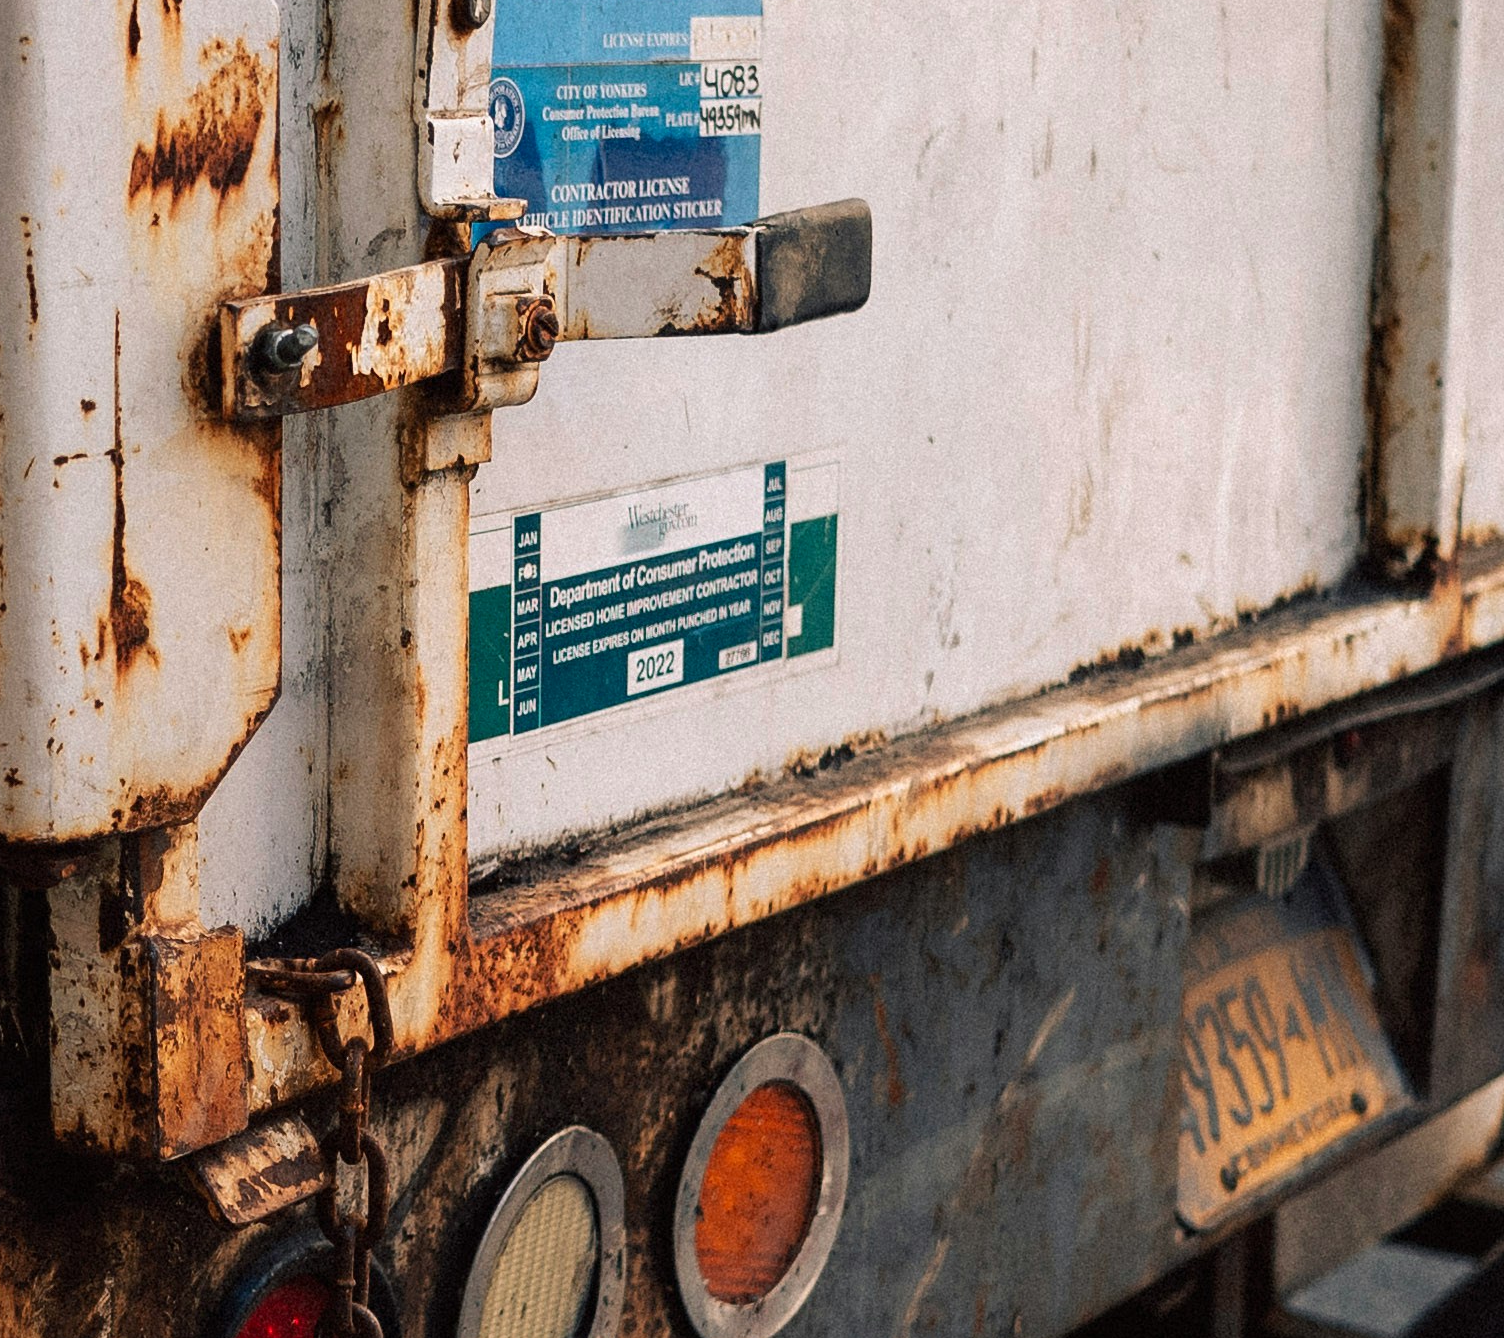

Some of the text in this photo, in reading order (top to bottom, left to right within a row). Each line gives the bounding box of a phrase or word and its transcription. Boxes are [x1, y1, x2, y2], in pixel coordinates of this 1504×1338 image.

[603, 32, 645, 48] LICENSE
[556, 83, 648, 100] CITY OF YONKERS
[705, 65, 759, 99] 4083
[542, 103, 660, 121] Consumer Protection Bureau
[561, 123, 641, 141] Office of Licensing
[551, 176, 690, 203] CONTRACTOR LICENSE
[572, 203, 673, 226] IDENTIFICATION
[673, 198, 722, 220] STICKER
[767, 476, 783, 493] JUL
[628, 502, 689, 529] Westchester
[765, 507, 783, 524] AUG
[518, 531, 537, 548] JAN
[765, 537, 782, 555] SEP
[518, 565, 537, 583] FB
[550, 541, 755, 610] Department of Consumer Protection
[764, 567, 782, 586] OCT
[517, 597, 539, 616] MAR
[545, 568, 758, 638] LICENSED HOME IMPROVEMENT CONTRACTOR
[763, 599, 781, 618] NOV
[517, 632, 537, 650] APR
[553, 599, 751, 665] LICENSE EXPIRES ON MONTH PUNCHED IN YEAR
[763, 630, 780, 648] DEC
[516, 664, 537, 684] MAY
[636, 650, 675, 683] 2022
[517, 697, 536, 717] JUN
